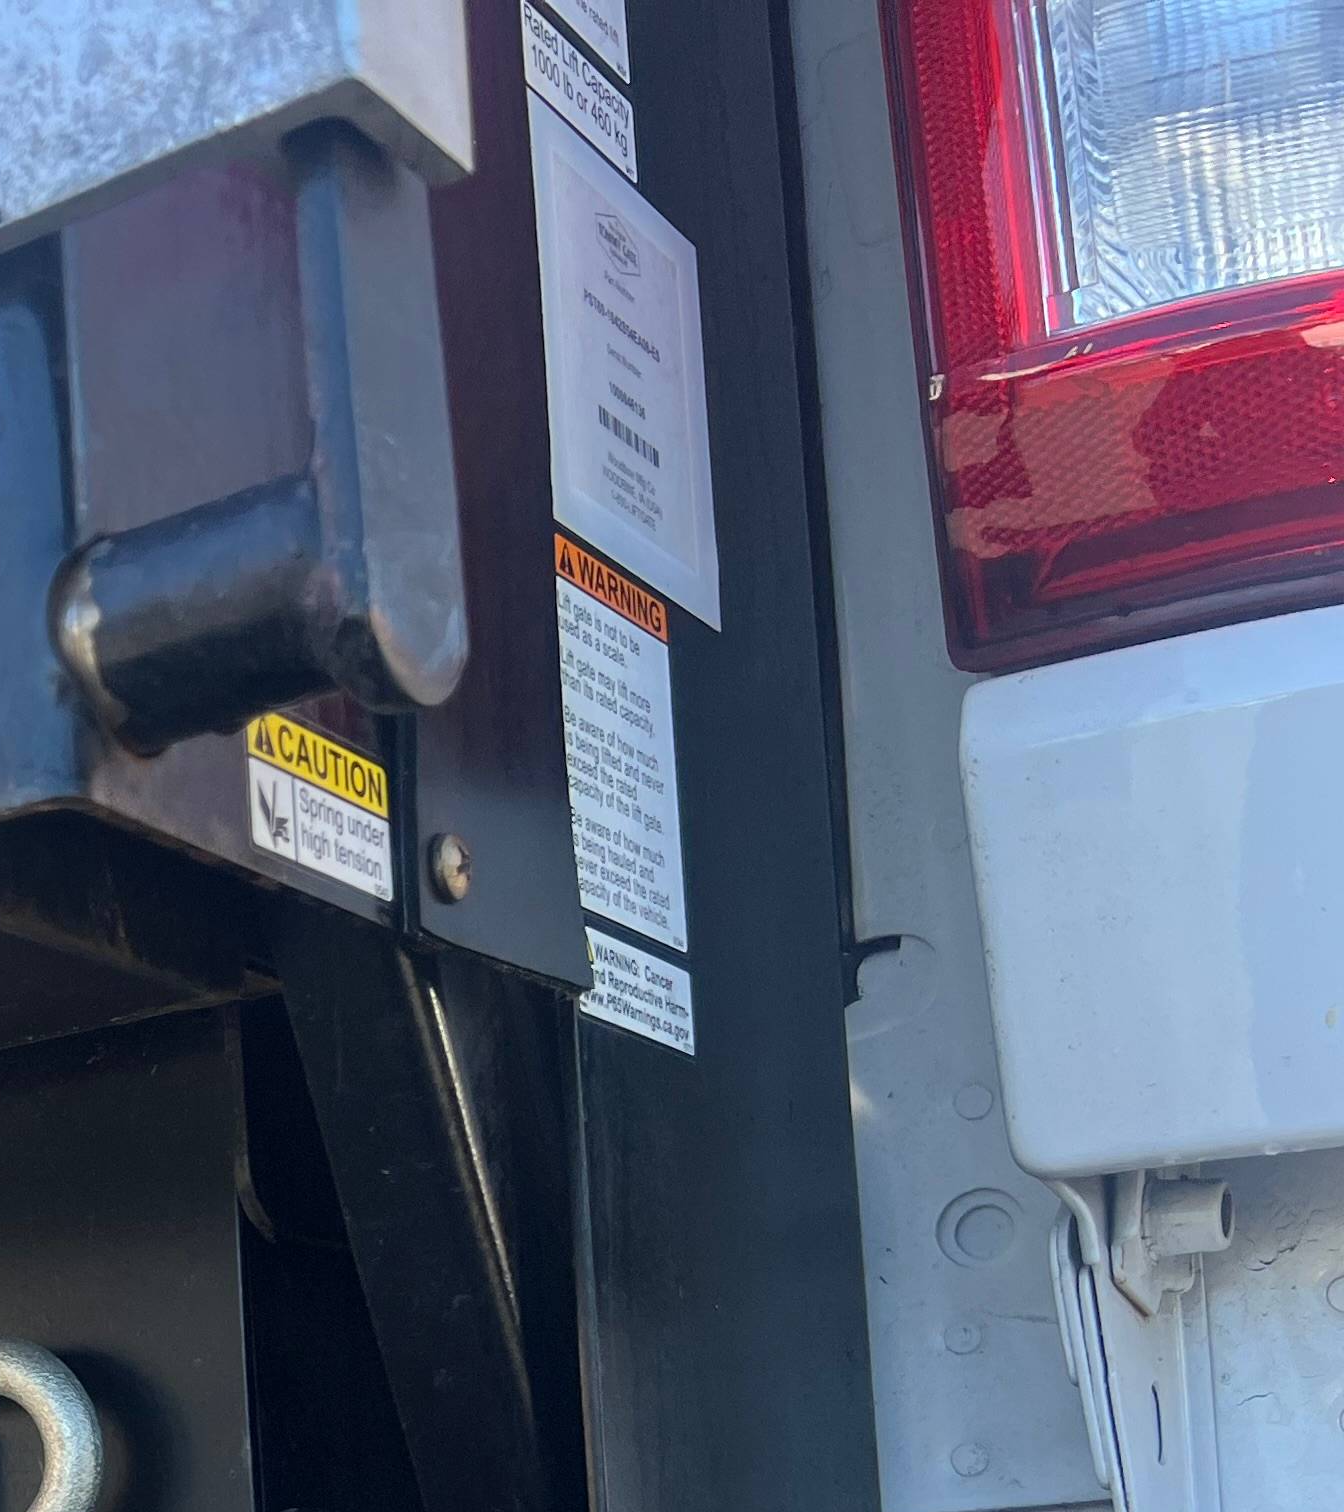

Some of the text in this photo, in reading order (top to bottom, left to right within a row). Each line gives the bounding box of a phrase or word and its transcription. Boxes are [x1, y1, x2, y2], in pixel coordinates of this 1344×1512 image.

[524, 5, 558, 56] Rated
[562, 43, 580, 77] Lift
[582, 61, 630, 129] Capacity
[531, 44, 628, 158] 1000 lb or 460 kg
[578, 551, 662, 632] WARNING
[278, 725, 382, 808] CAUTION
[299, 788, 385, 849] Spring under
[301, 823, 380, 881] high tension
[608, 971, 663, 1009] Reproductive
[644, 965, 673, 991] Cancer
